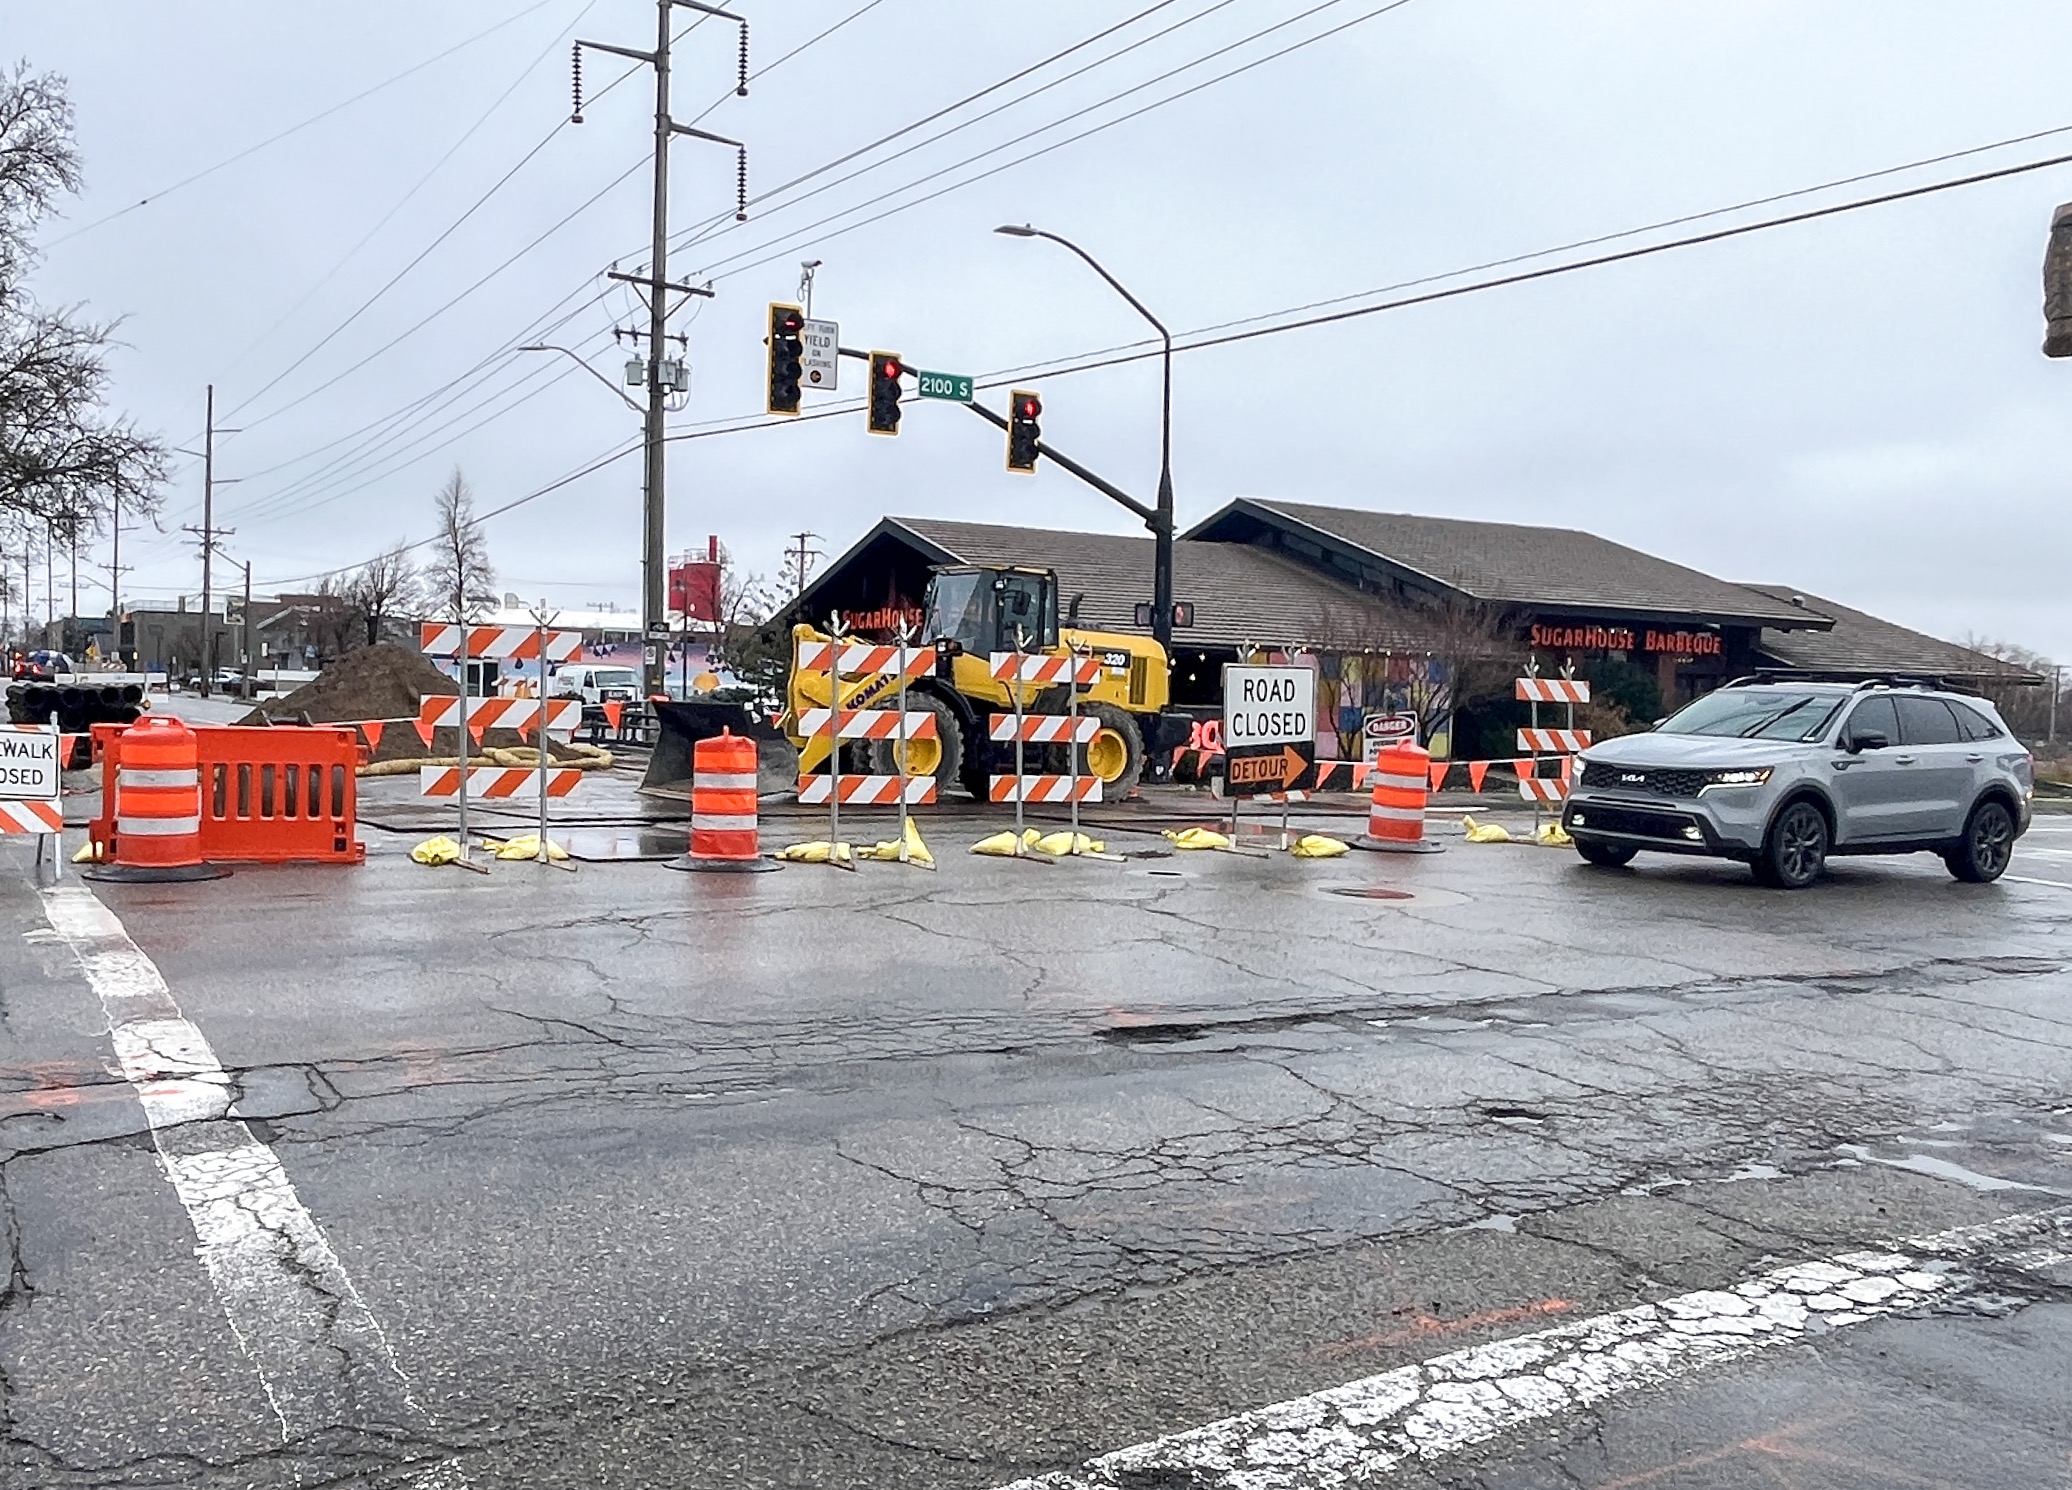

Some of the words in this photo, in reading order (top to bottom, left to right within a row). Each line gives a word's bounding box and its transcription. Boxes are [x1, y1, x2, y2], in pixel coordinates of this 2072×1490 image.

[805, 334, 830, 348] YIELD
[921, 377, 953, 395] 2100
[1531, 624, 1635, 650] SUGARHOUSE
[1645, 630, 1722, 655] BARBEQUE
[1243, 678, 1295, 702] ROAD
[1232, 712, 1306, 736] CLOSED
[0, 741, 53, 759] WALK
[1232, 758, 1288, 781] DETOUR
